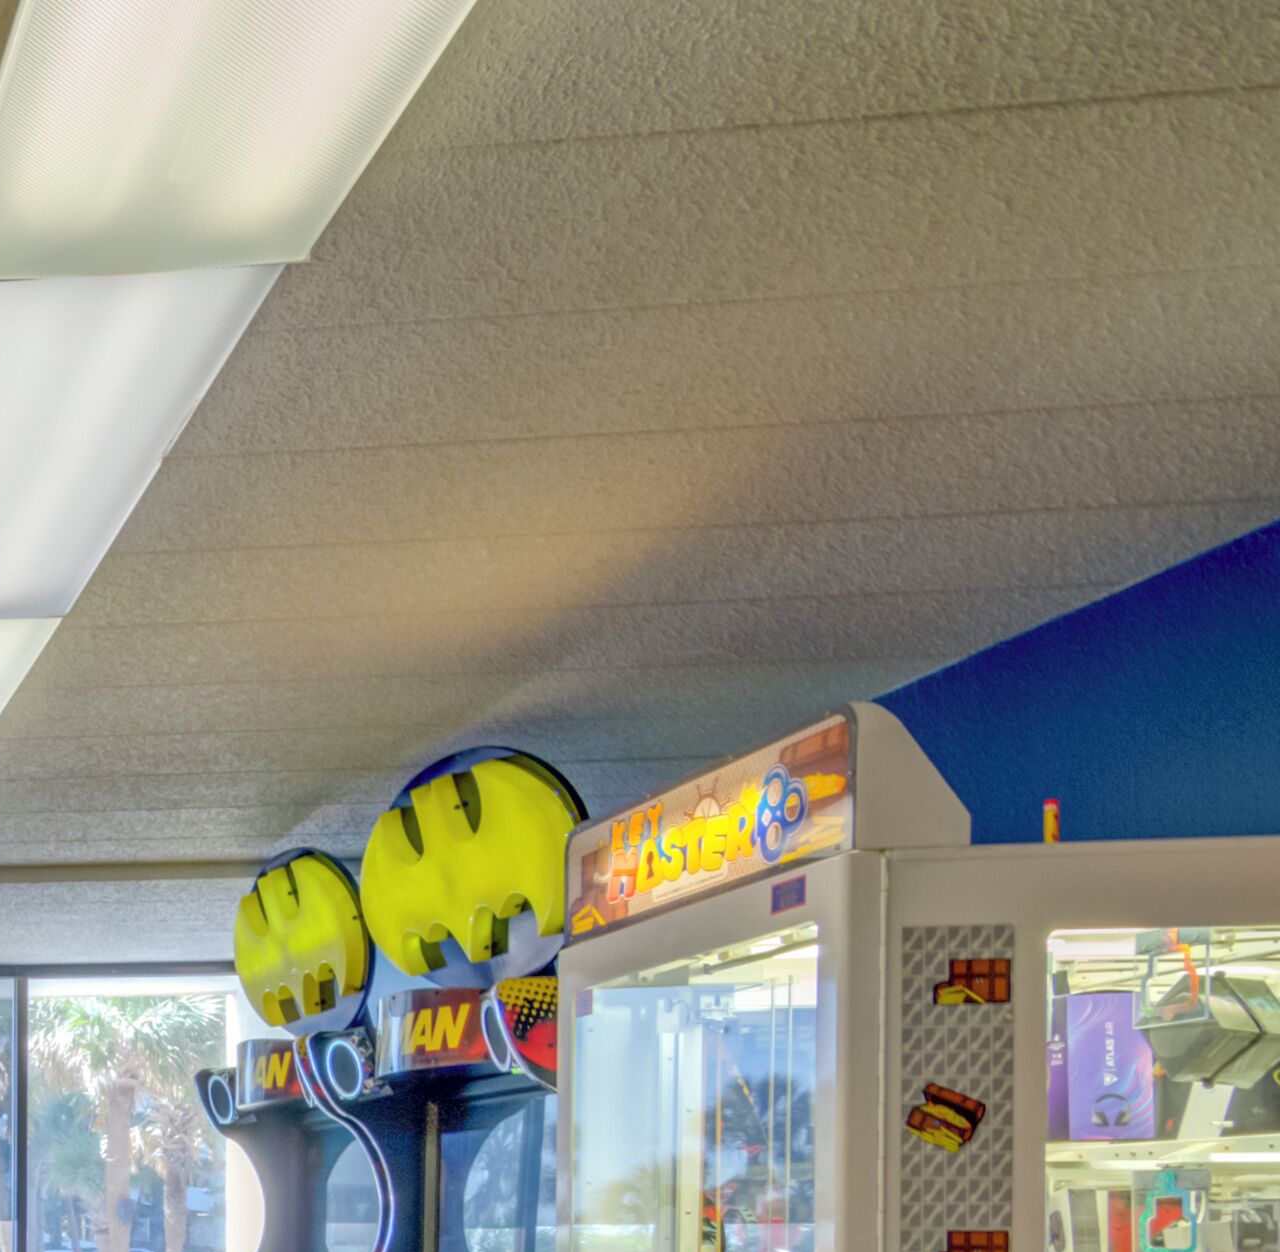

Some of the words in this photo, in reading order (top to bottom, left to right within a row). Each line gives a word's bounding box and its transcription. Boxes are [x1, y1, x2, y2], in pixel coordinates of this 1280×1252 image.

[608, 802, 756, 903] MASTER
[612, 803, 664, 852] KEY
[402, 1003, 471, 1055] AN
